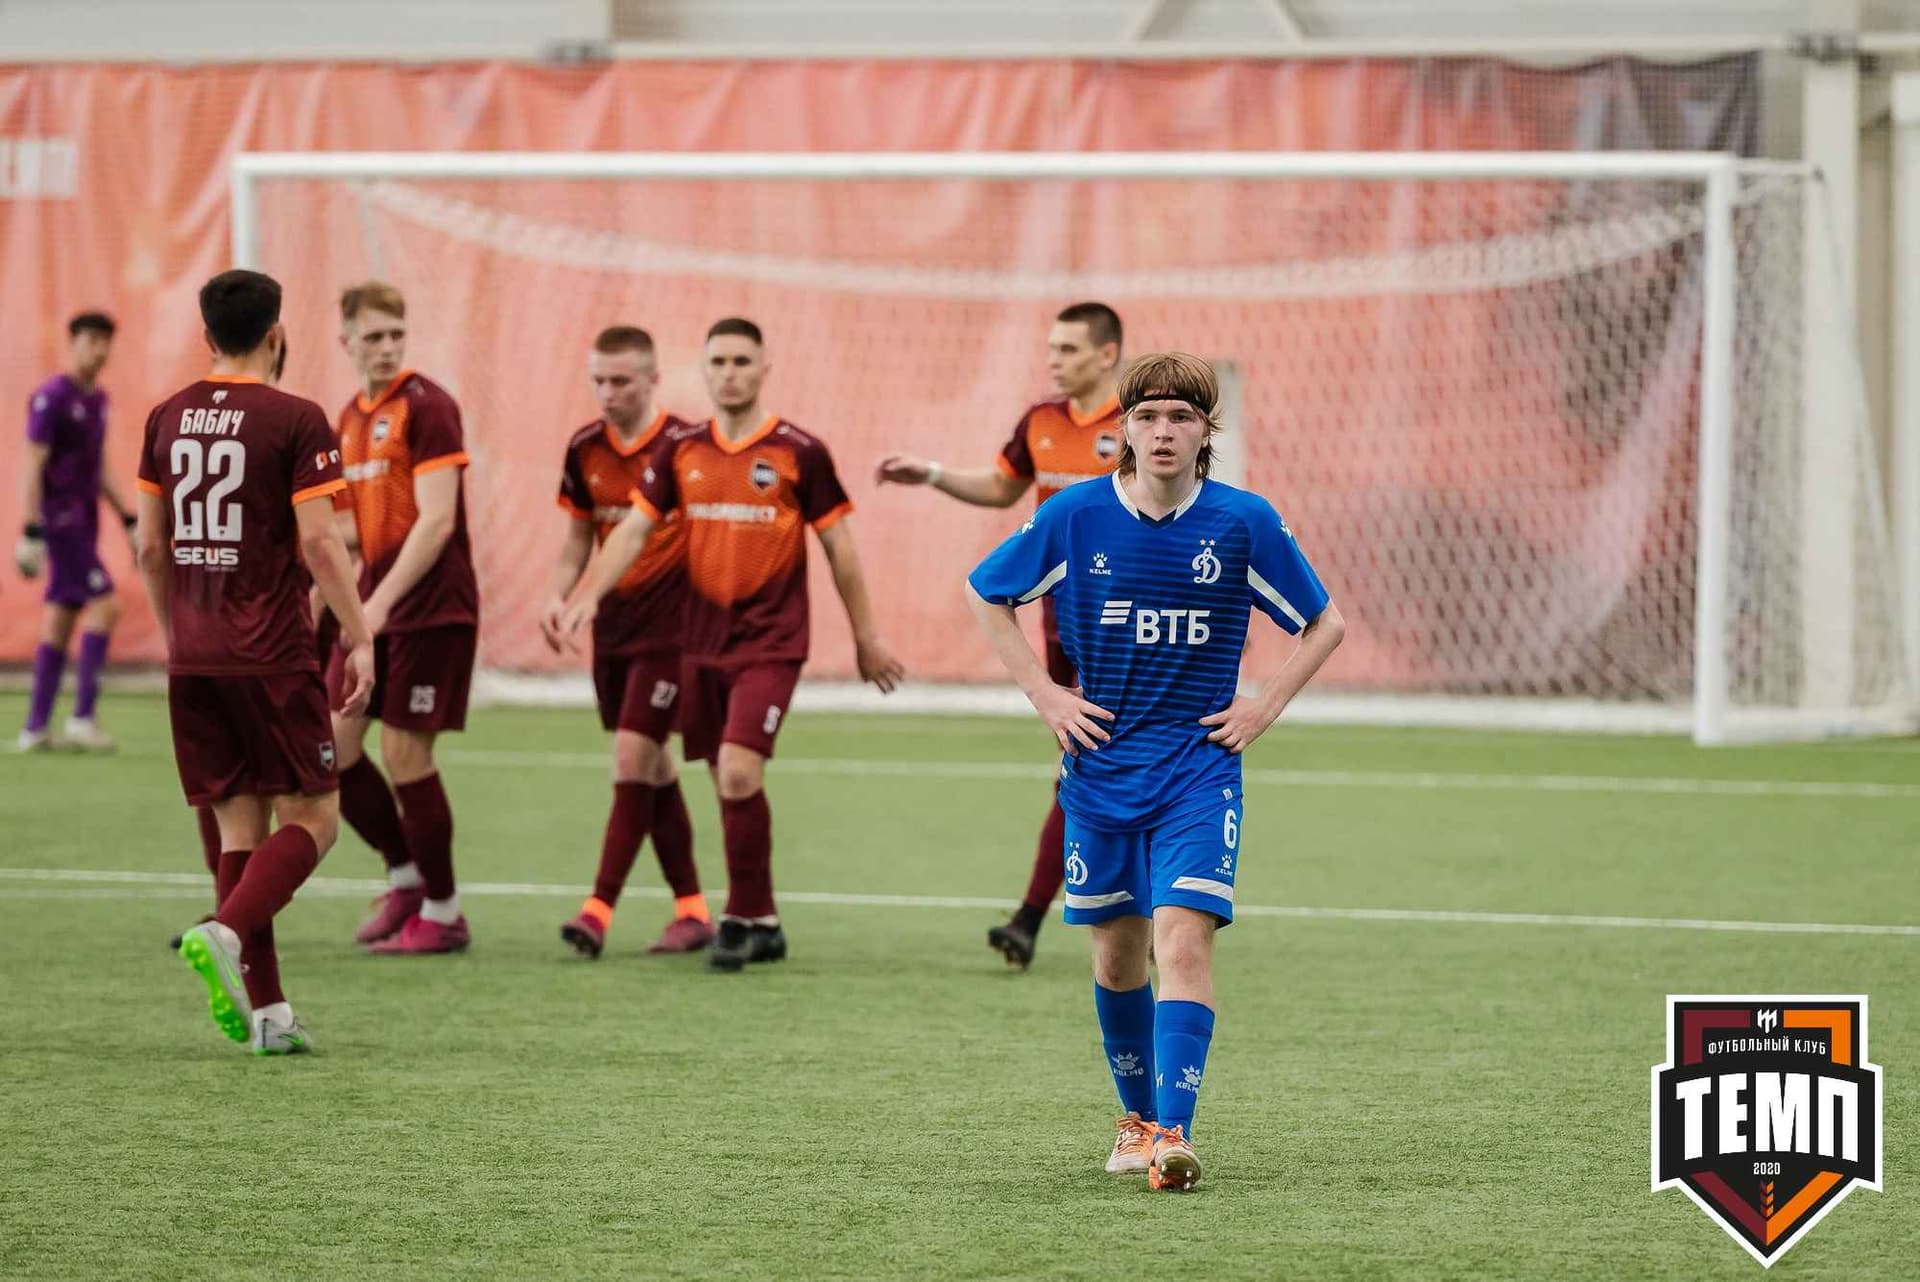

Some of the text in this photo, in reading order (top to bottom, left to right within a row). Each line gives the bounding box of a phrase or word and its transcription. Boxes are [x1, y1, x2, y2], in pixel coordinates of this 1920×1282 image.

[179, 408, 245, 436] БАБИЧ
[170, 438, 246, 542] 22
[174, 547, 239, 565] SEUS
[1089, 567, 1112, 576] KELME
[1136, 609, 1211, 645] ВТБ
[1223, 808, 1237, 850] 6
